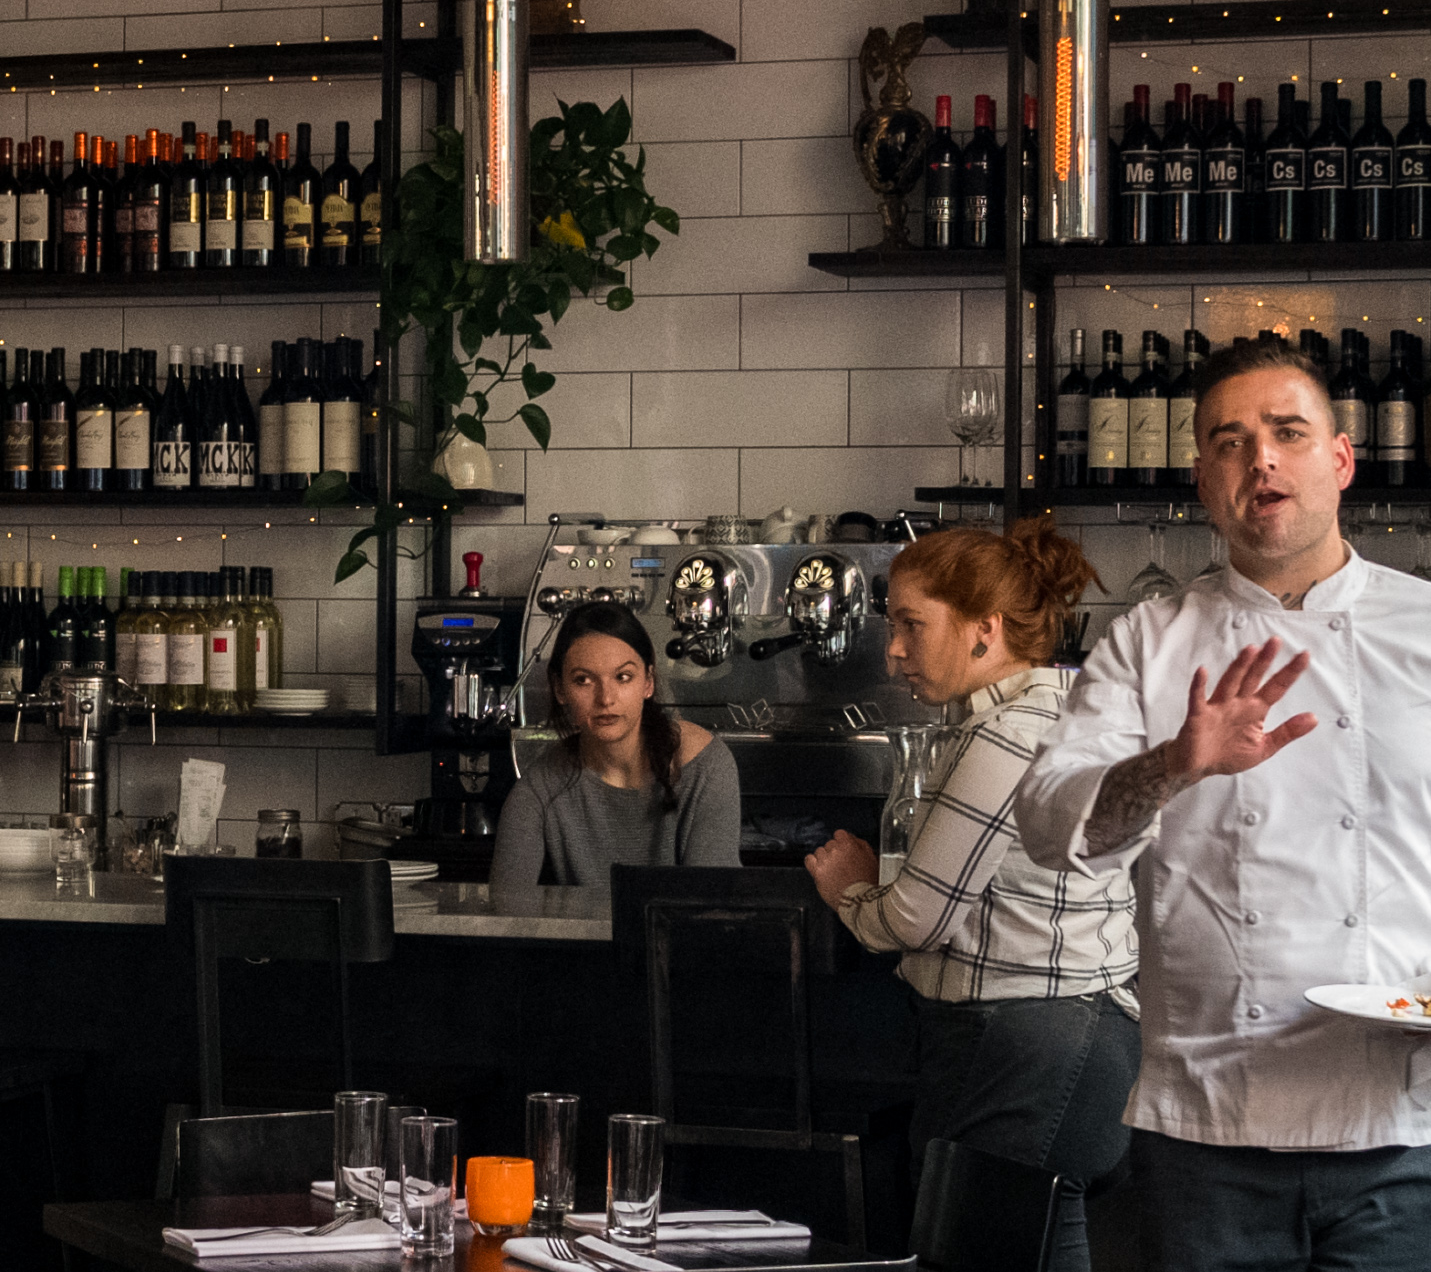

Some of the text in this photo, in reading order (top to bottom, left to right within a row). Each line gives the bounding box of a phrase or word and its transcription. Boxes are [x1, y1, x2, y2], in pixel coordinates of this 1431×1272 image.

[1126, 163, 1154, 183] Me
[1165, 161, 1193, 182] Me
[1209, 160, 1237, 181] Me
[1273, 161, 1296, 179] Cs
[1314, 159, 1336, 178] Cs
[1360, 159, 1383, 177] Cs
[1402, 157, 1424, 176] Cs
